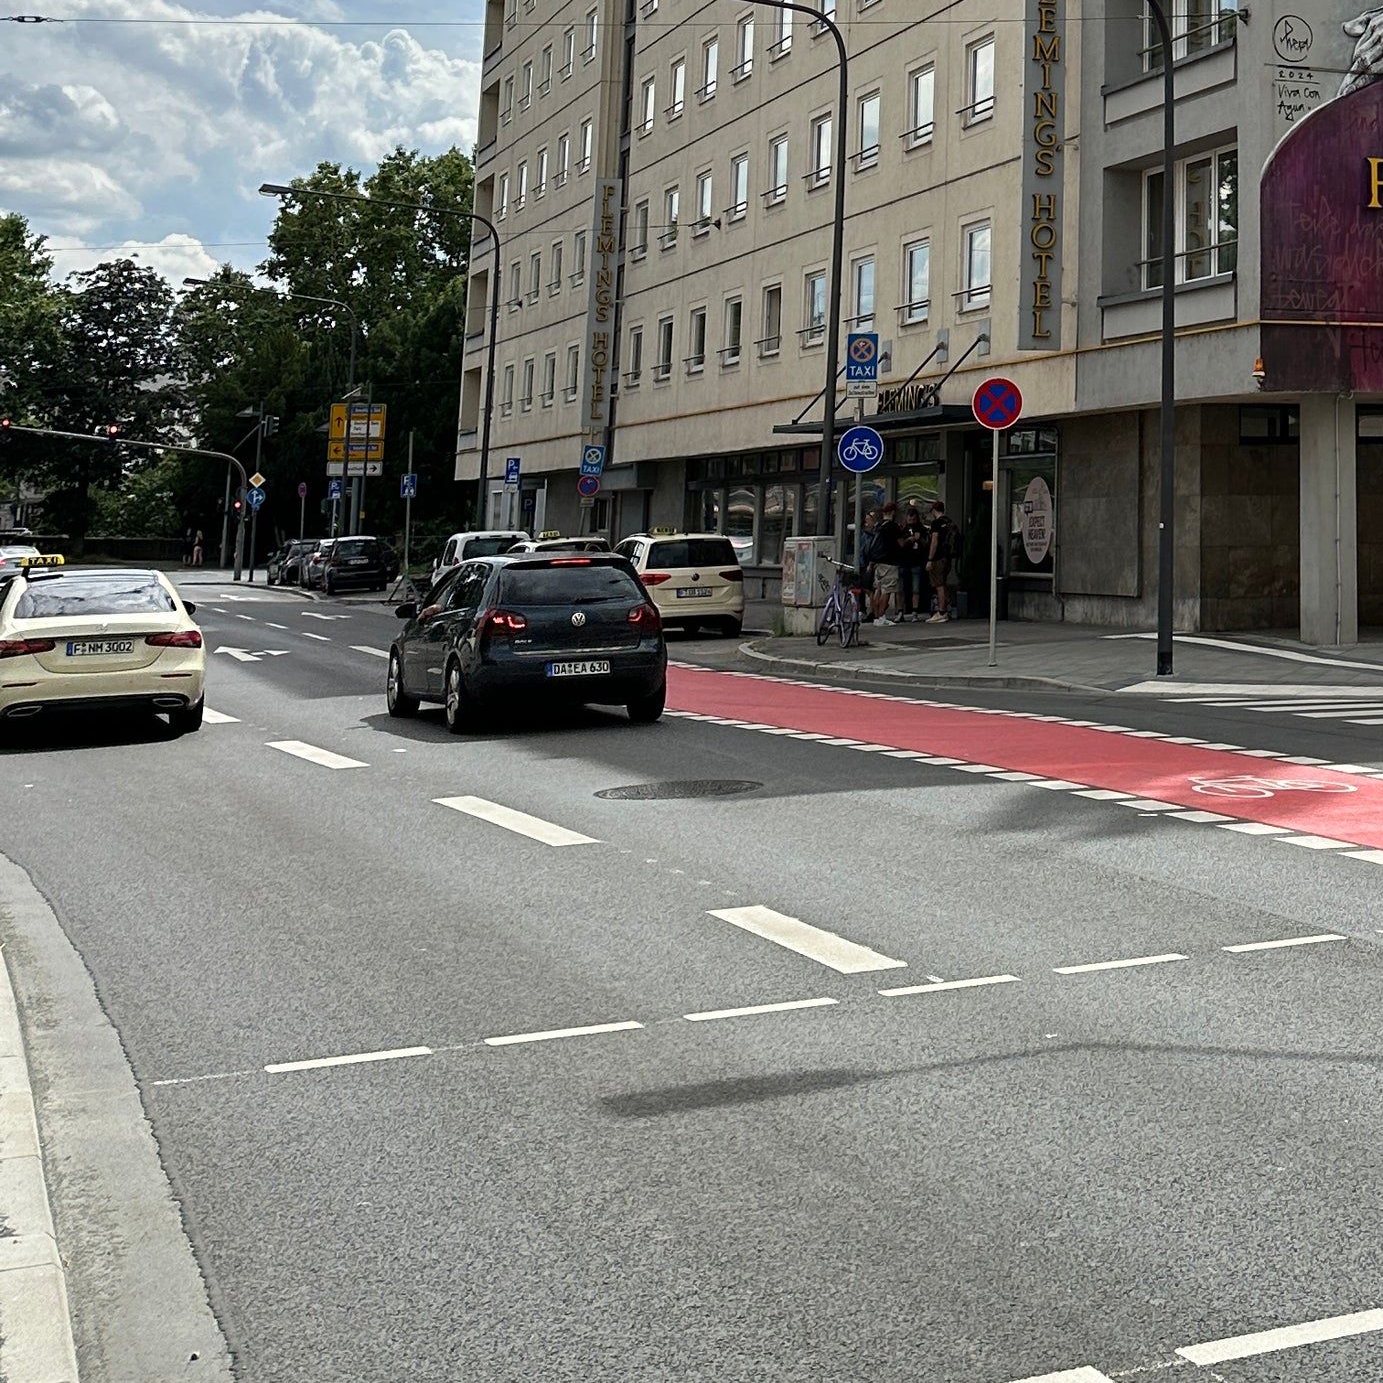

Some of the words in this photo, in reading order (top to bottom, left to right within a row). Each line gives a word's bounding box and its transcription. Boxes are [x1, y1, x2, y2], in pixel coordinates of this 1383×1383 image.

[1278, 84, 1301, 99] Viva
[1030, 194, 1057, 339] HOTEL
[590, 332, 609, 420] HOTEL
[848, 365, 875, 377] TAXI
[583, 465, 600, 474] TAXI
[30, 557, 57, 565] TAXI
[105, 642, 132, 653] 3002
[553, 662, 568, 675] DA
[573, 662, 588, 674] EA
[589, 660, 609, 673] 630
